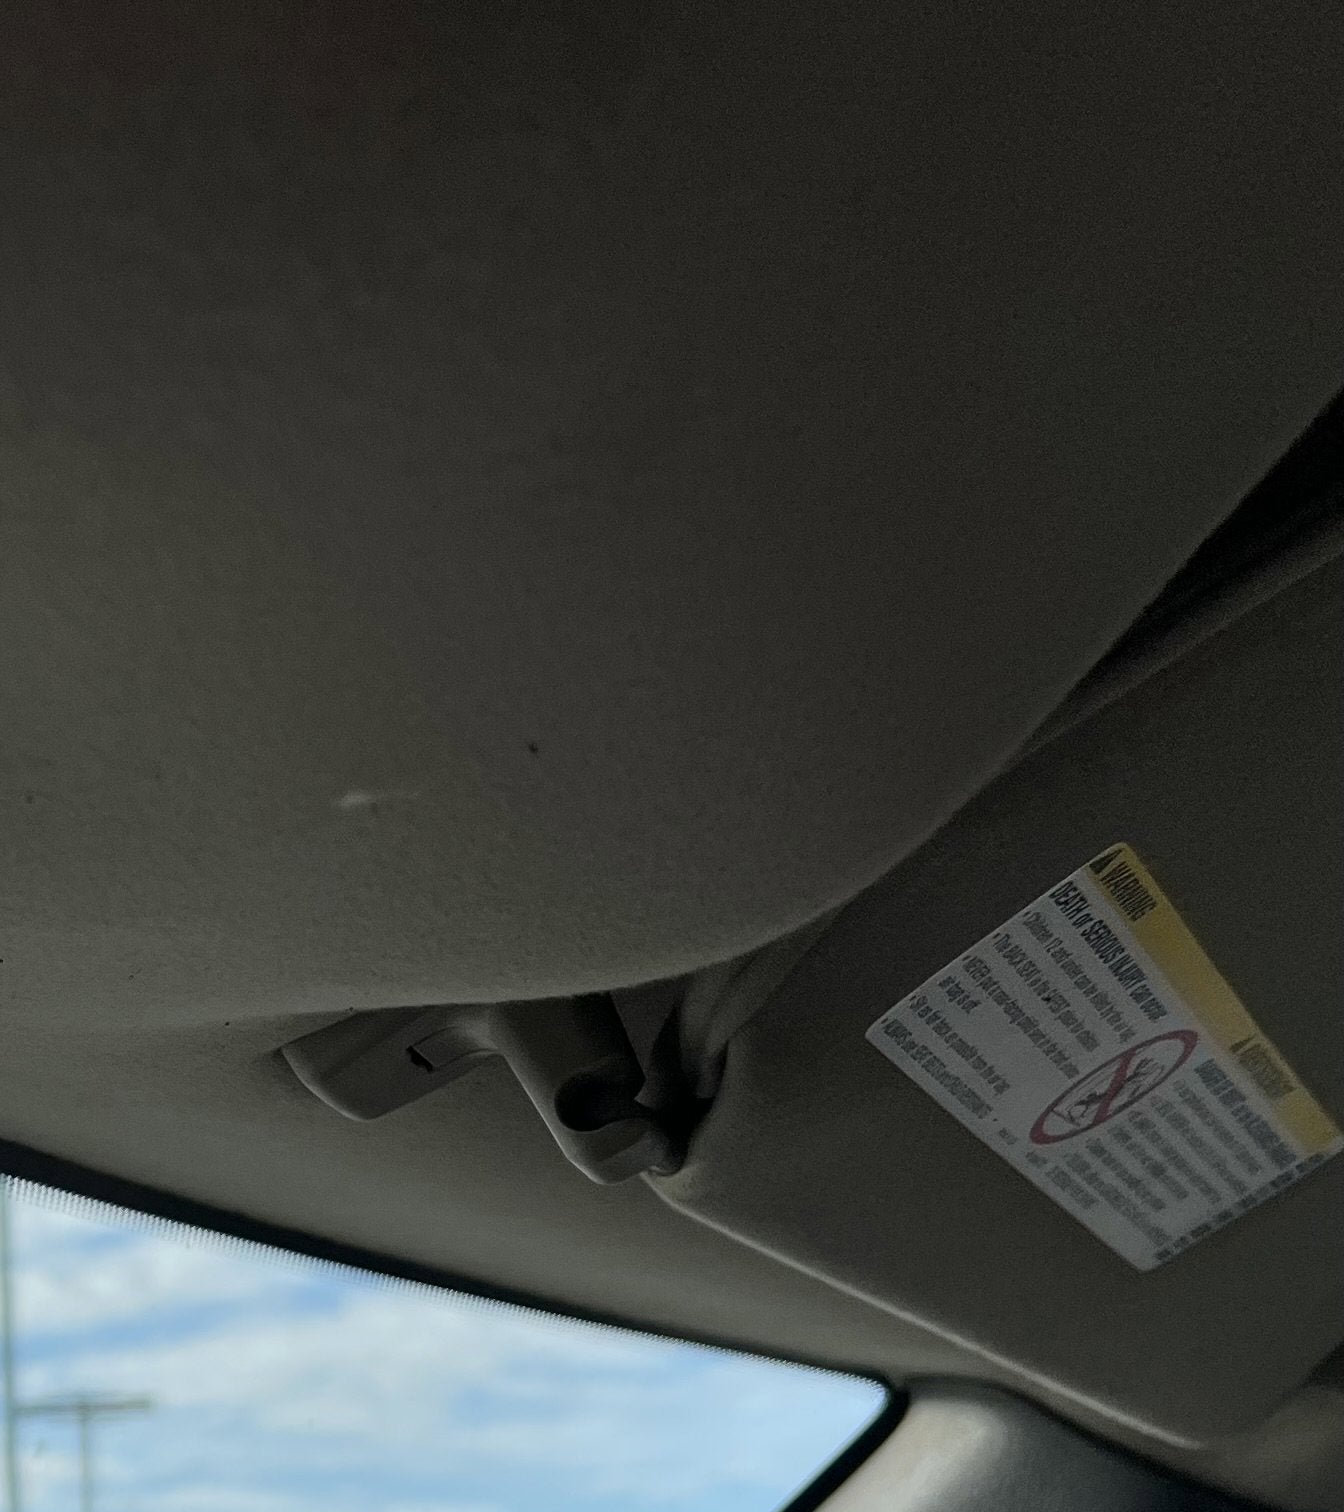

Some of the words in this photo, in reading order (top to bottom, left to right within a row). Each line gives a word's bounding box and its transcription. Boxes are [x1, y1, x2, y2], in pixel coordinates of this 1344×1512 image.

[1048, 879, 1090, 921] DEATH
[1099, 860, 1158, 923] WARNING
[1022, 911, 1056, 944] Children
[1070, 910, 1094, 931] or
[1043, 937, 1062, 953] 12
[1050, 944, 1071, 964] and
[1078, 917, 1126, 966] SERIOUS
[961, 955, 991, 982] NEVER
[1001, 945, 1027, 968] BACK
[1015, 960, 1040, 982] SEAT
[1106, 952, 1148, 992] INJURY
